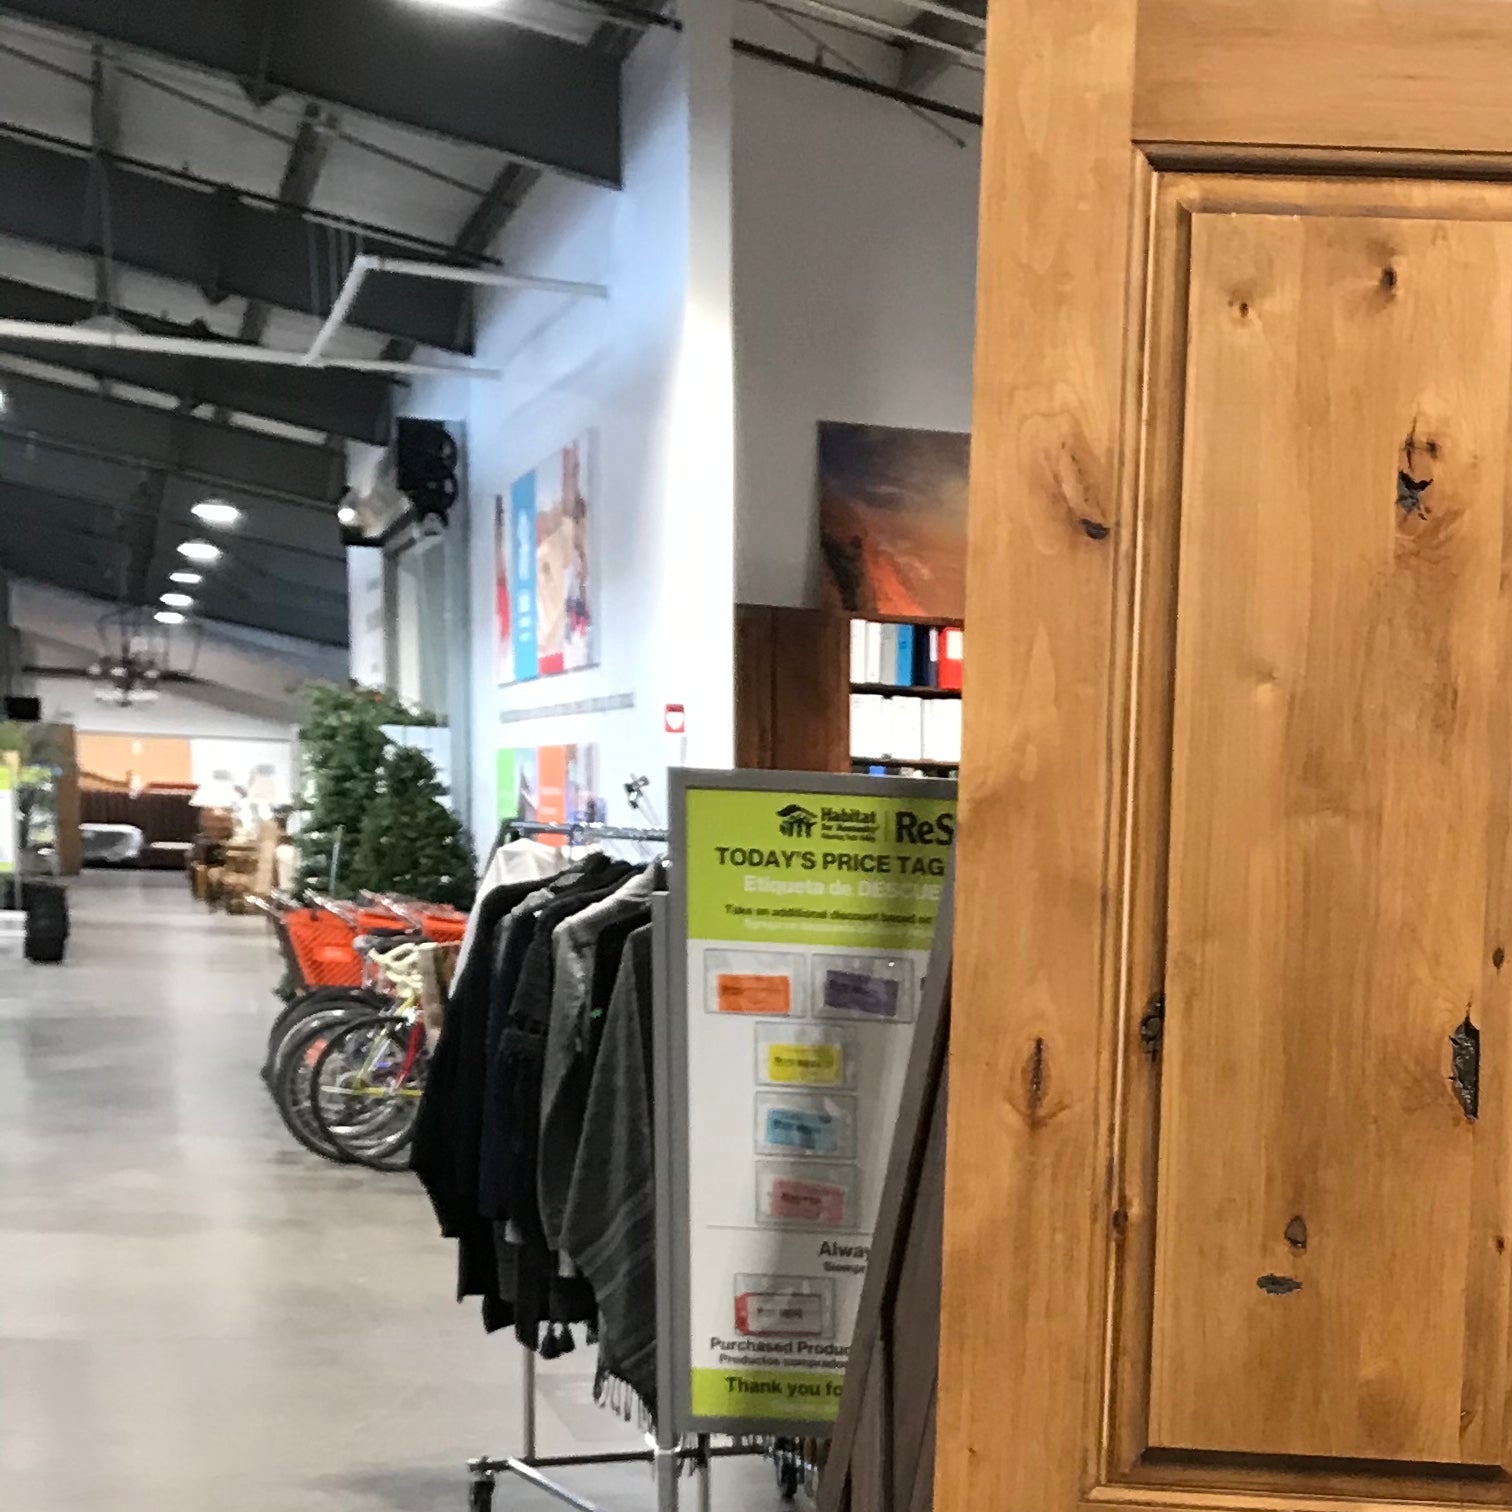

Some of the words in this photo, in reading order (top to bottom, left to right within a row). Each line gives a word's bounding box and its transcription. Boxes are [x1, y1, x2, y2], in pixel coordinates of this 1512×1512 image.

[714, 846, 817, 870] TODAY'S
[822, 852, 891, 874] PRICE
[897, 856, 945, 876] TAG
[829, 879, 852, 896] de
[710, 1336, 793, 1353] Purchased
[725, 1376, 782, 1395] Thank
[787, 1382, 821, 1398] you
